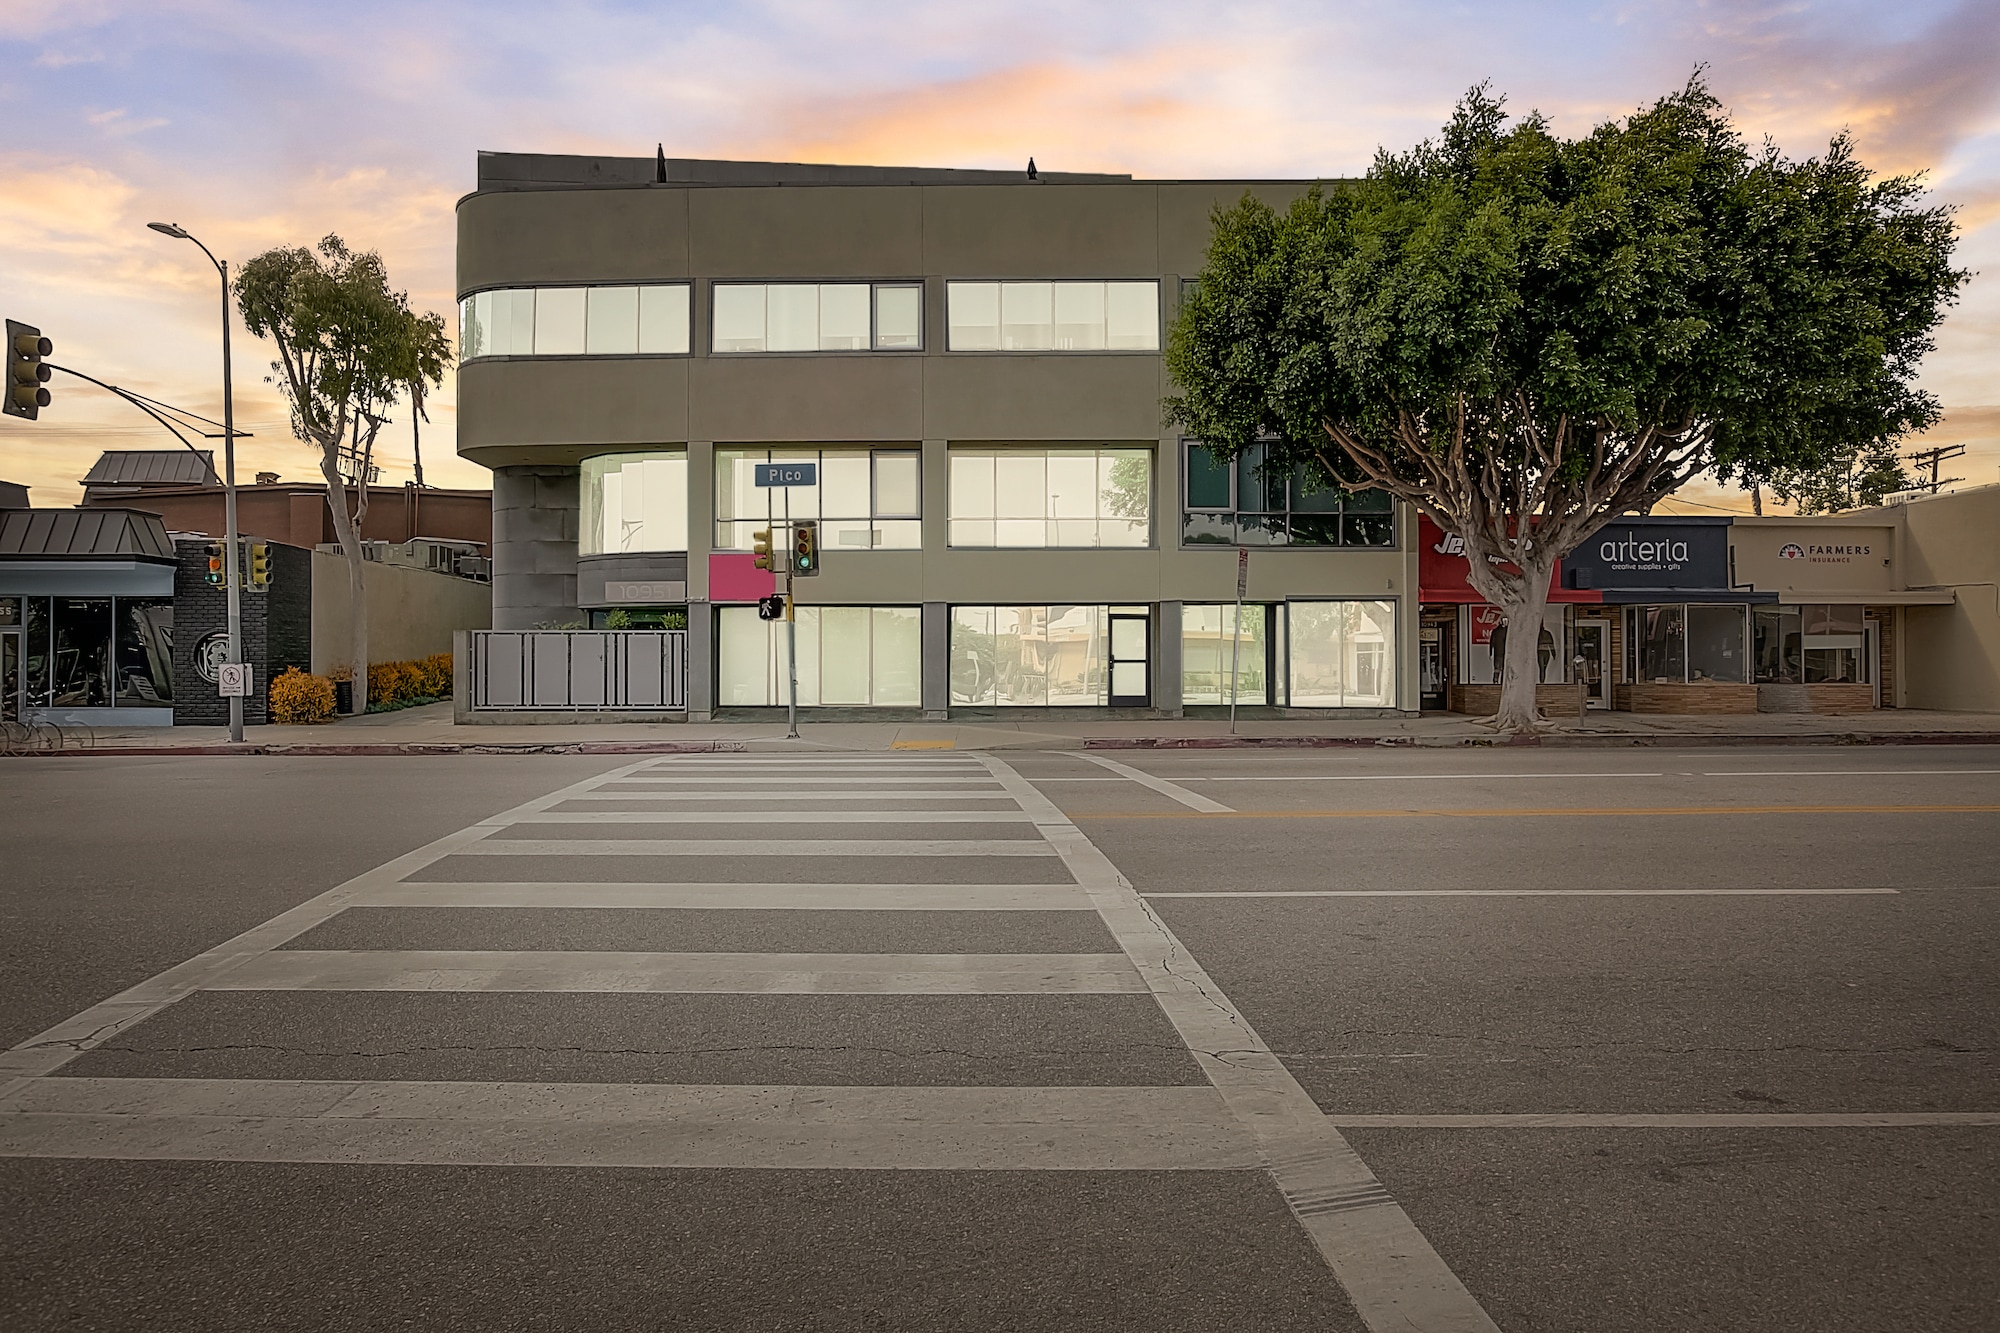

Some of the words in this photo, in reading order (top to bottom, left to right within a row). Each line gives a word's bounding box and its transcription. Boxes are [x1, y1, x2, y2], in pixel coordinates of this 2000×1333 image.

[769, 468, 801, 481] Pico
[1600, 531, 1689, 562] arteria
[1809, 545, 1870, 555] FARMERS
[1638, 563, 1661, 571] supplies
[620, 585, 671, 599] 10951
